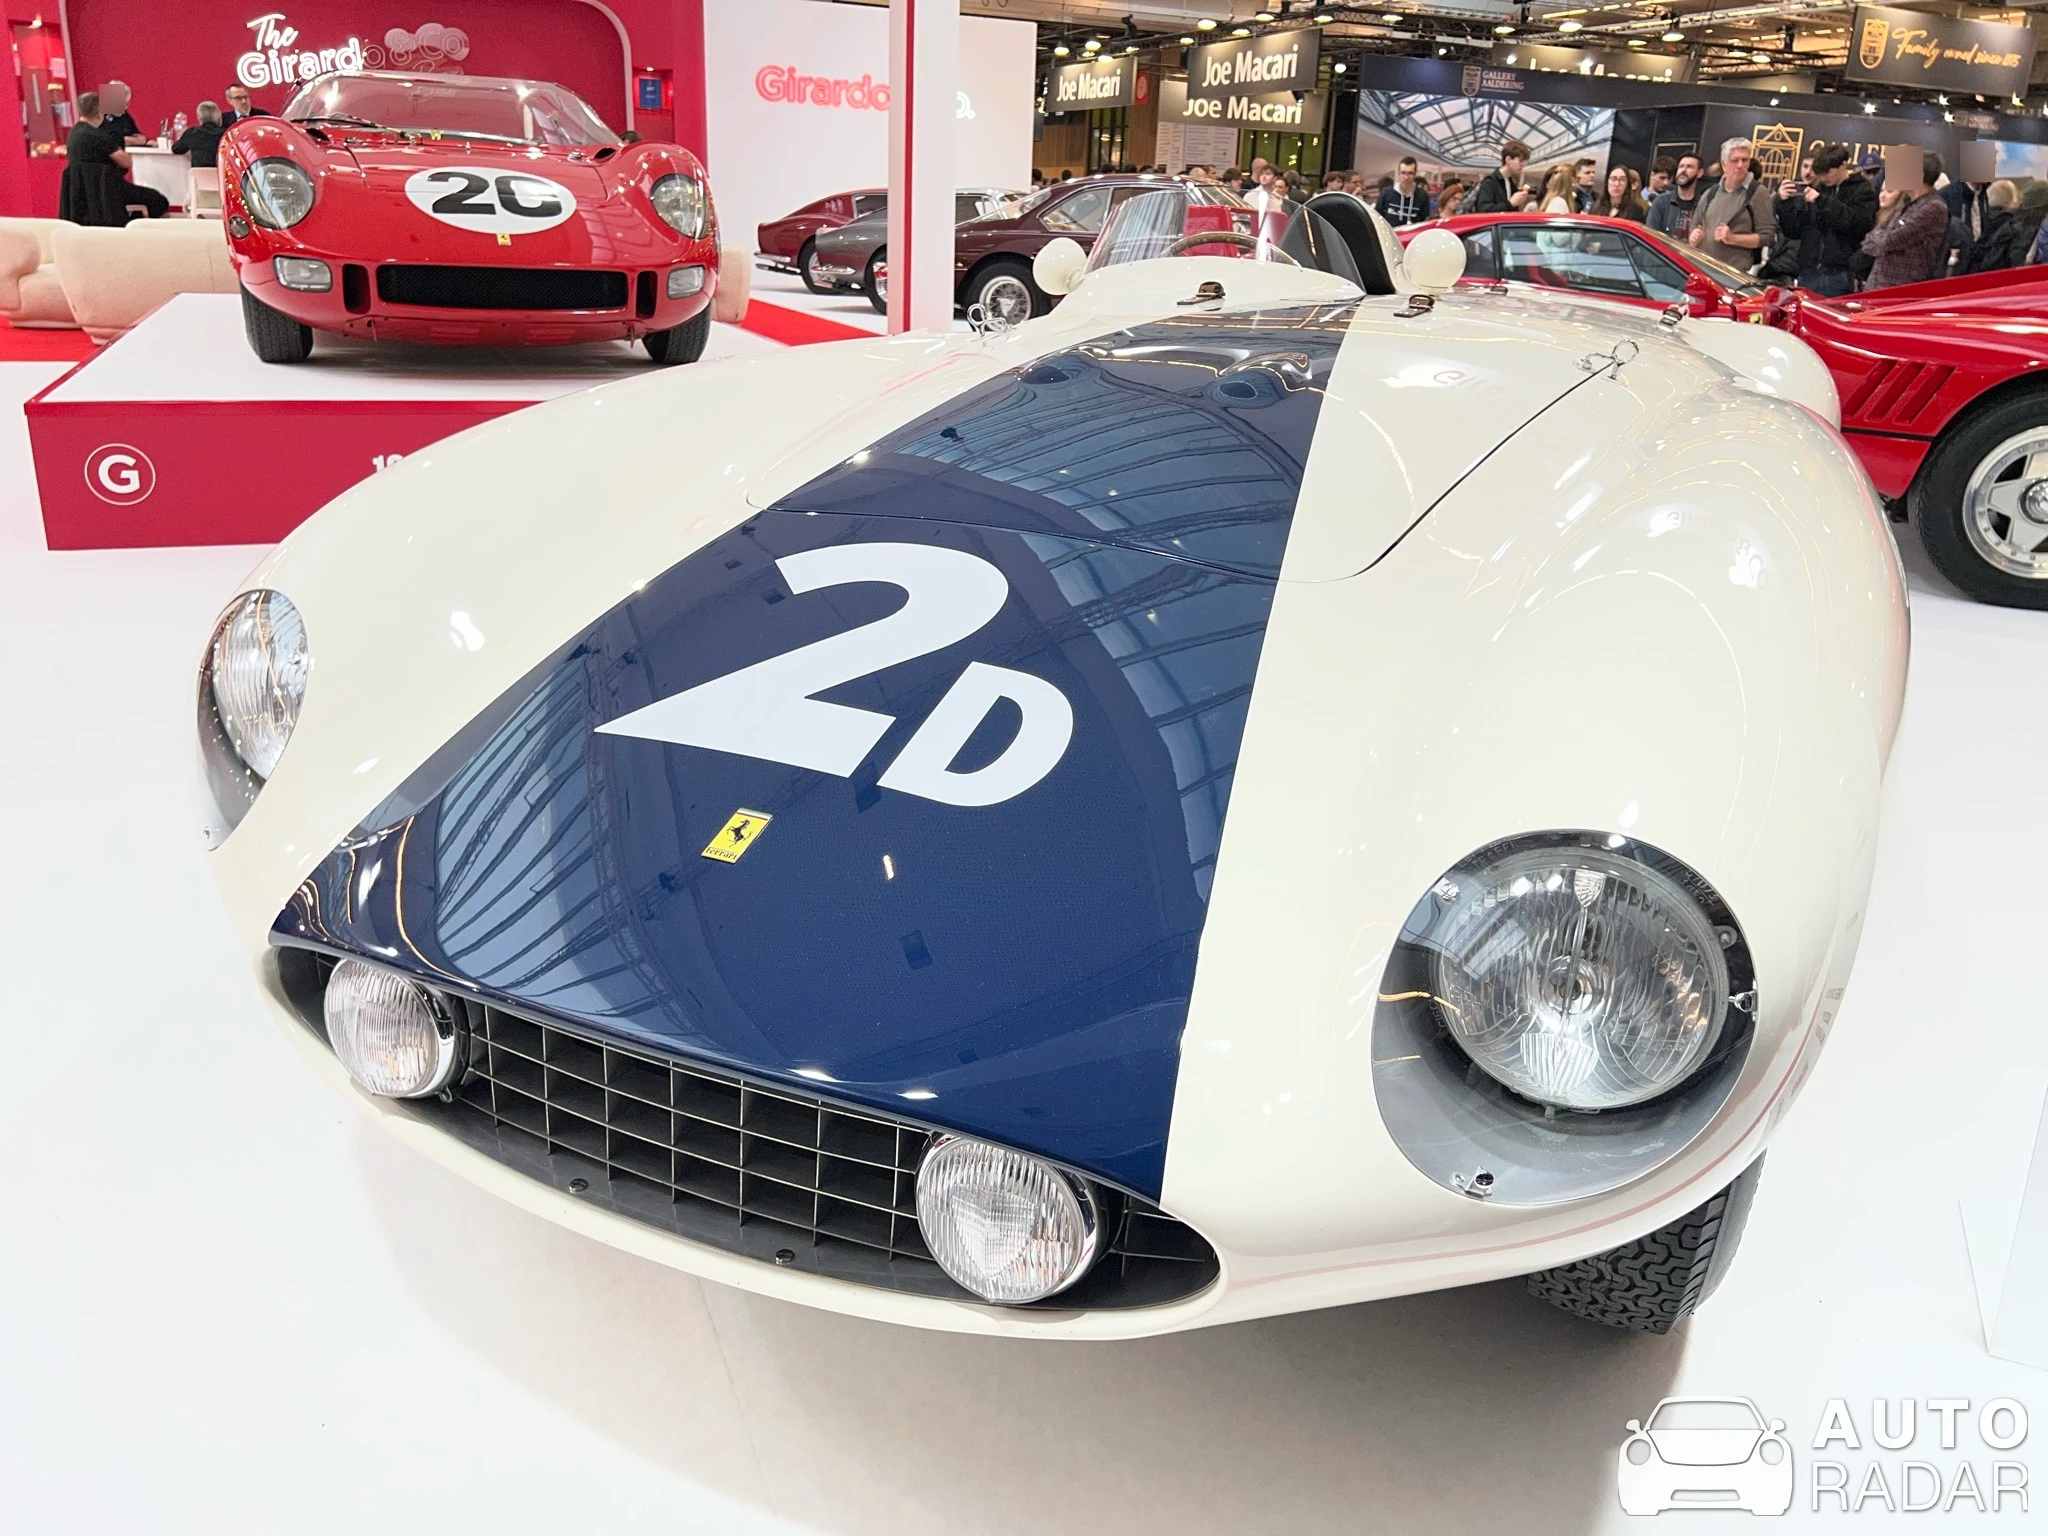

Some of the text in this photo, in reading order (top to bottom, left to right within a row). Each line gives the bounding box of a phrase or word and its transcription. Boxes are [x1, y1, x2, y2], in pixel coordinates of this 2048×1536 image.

[247, 13, 298, 51] The
[1891, 27, 1940, 69] Family
[1056, 69, 1121, 101] Joe Macari
[1202, 44, 1299, 88] Joe Macari
[1481, 79, 1525, 90] AALDERING
[1482, 70, 1516, 81] GALLERY
[755, 65, 890, 111] Girardo
[1183, 96, 1302, 124] Joe Macari
[98, 454, 140, 494] G
